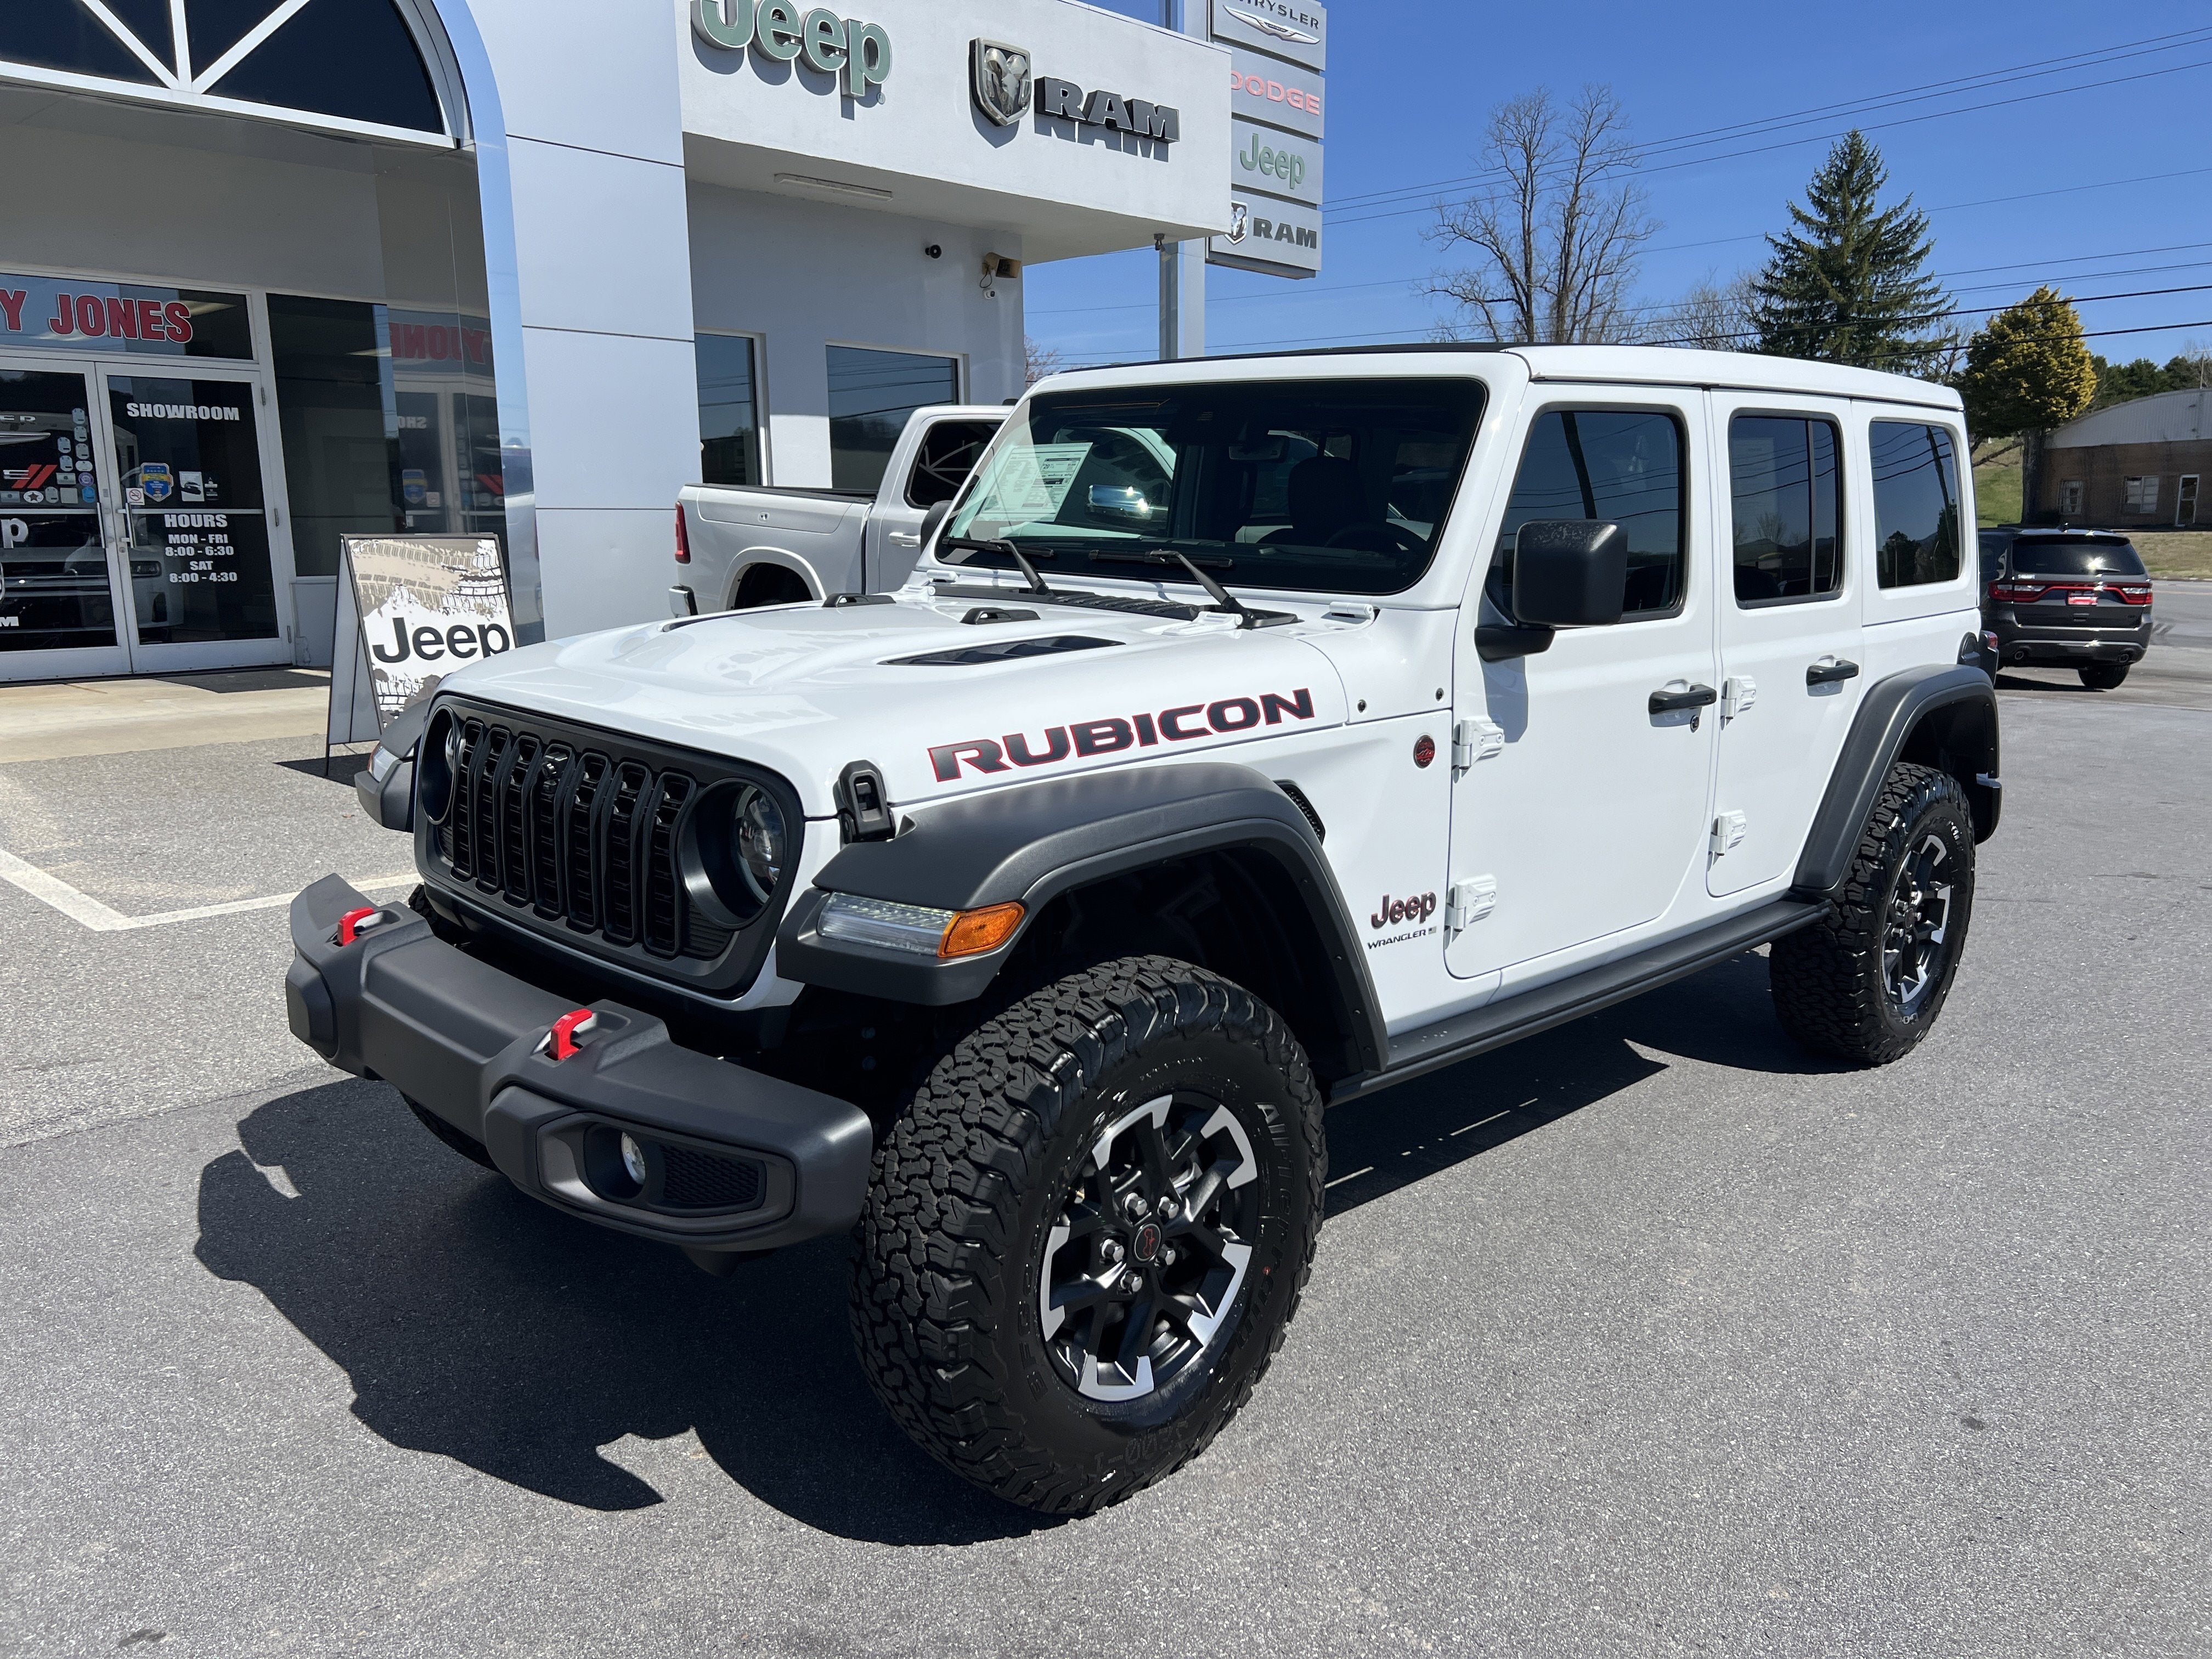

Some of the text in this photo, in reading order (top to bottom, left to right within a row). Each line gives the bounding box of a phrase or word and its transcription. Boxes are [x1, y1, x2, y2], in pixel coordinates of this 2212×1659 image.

[1239, 0, 1319, 30] RYSLER
[691, 0, 893, 97] Jeep
[1231, 70, 1320, 115] DODGE
[1035, 76, 1180, 143] RAM
[1239, 132, 1306, 190] Jeep
[1253, 217, 1317, 250] RAM
[48, 294, 193, 344] JONES
[126, 402, 240, 421] SHOWROOM
[164, 514, 228, 528] HOURS
[165, 546, 195, 556] 8:00
[205, 546, 234, 556] 6:30
[168, 534, 198, 544] MON
[208, 534, 228, 544] FRI
[169, 572, 199, 583] 8:00
[209, 572, 238, 582] 4:30
[189, 561, 213, 571] SAT
[372, 617, 510, 663] Jeep
[927, 687, 1314, 782] RUBICON
[1370, 891, 1437, 930] Jeep
[1367, 928, 1426, 950] WRANGLER
